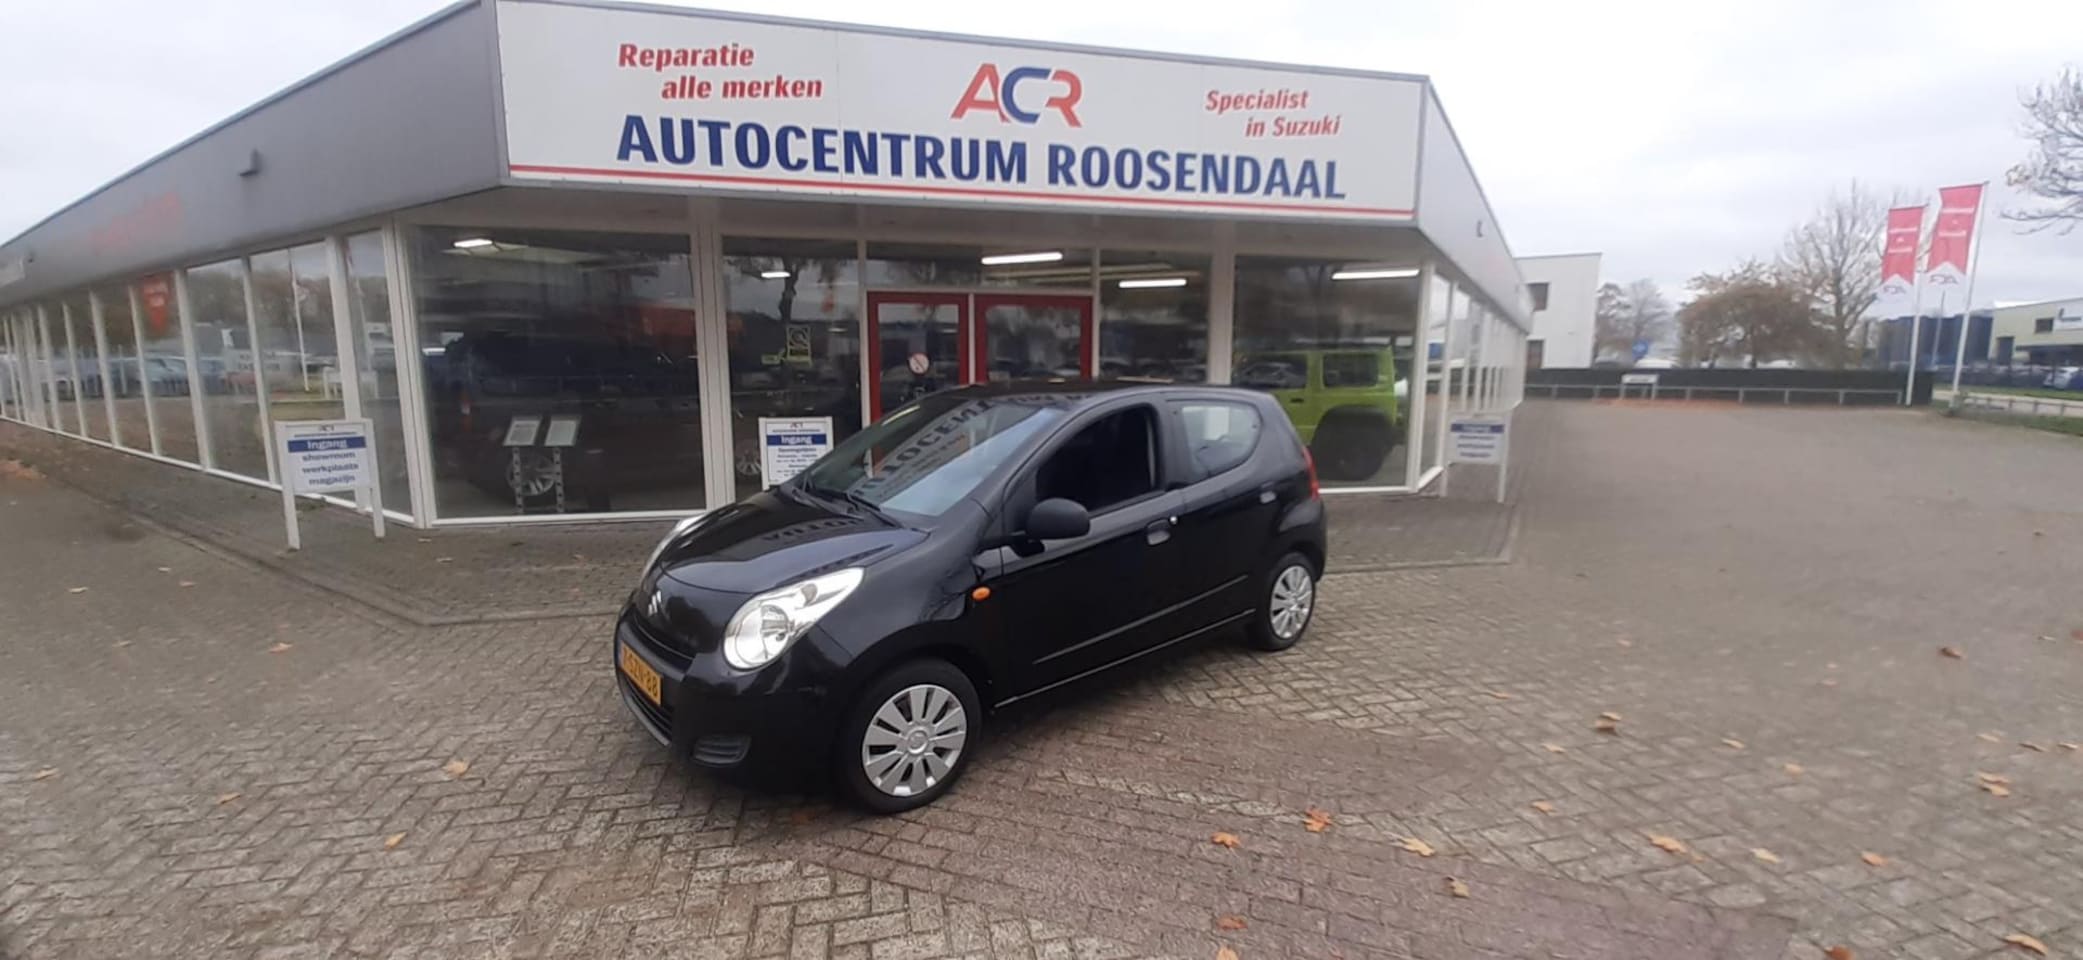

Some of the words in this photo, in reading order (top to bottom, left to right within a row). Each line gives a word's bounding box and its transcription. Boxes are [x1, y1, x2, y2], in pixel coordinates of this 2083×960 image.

[618, 43, 754, 72] Reparatie
[661, 75, 712, 100] alle
[722, 75, 823, 99] merken
[951, 63, 1082, 128] ACR
[1205, 89, 1309, 116] Specialist
[1245, 117, 1265, 137] in
[1272, 116, 1340, 137] Suzuki
[617, 114, 1027, 184] AUTOCENTRUM
[1048, 143, 1346, 200] ROOSENDAAL
[307, 439, 348, 450] Ingang
[781, 434, 813, 445] Ingang
[302, 451, 356, 461] showroom
[301, 463, 359, 473] werkplaats
[308, 474, 356, 486] magazijn
